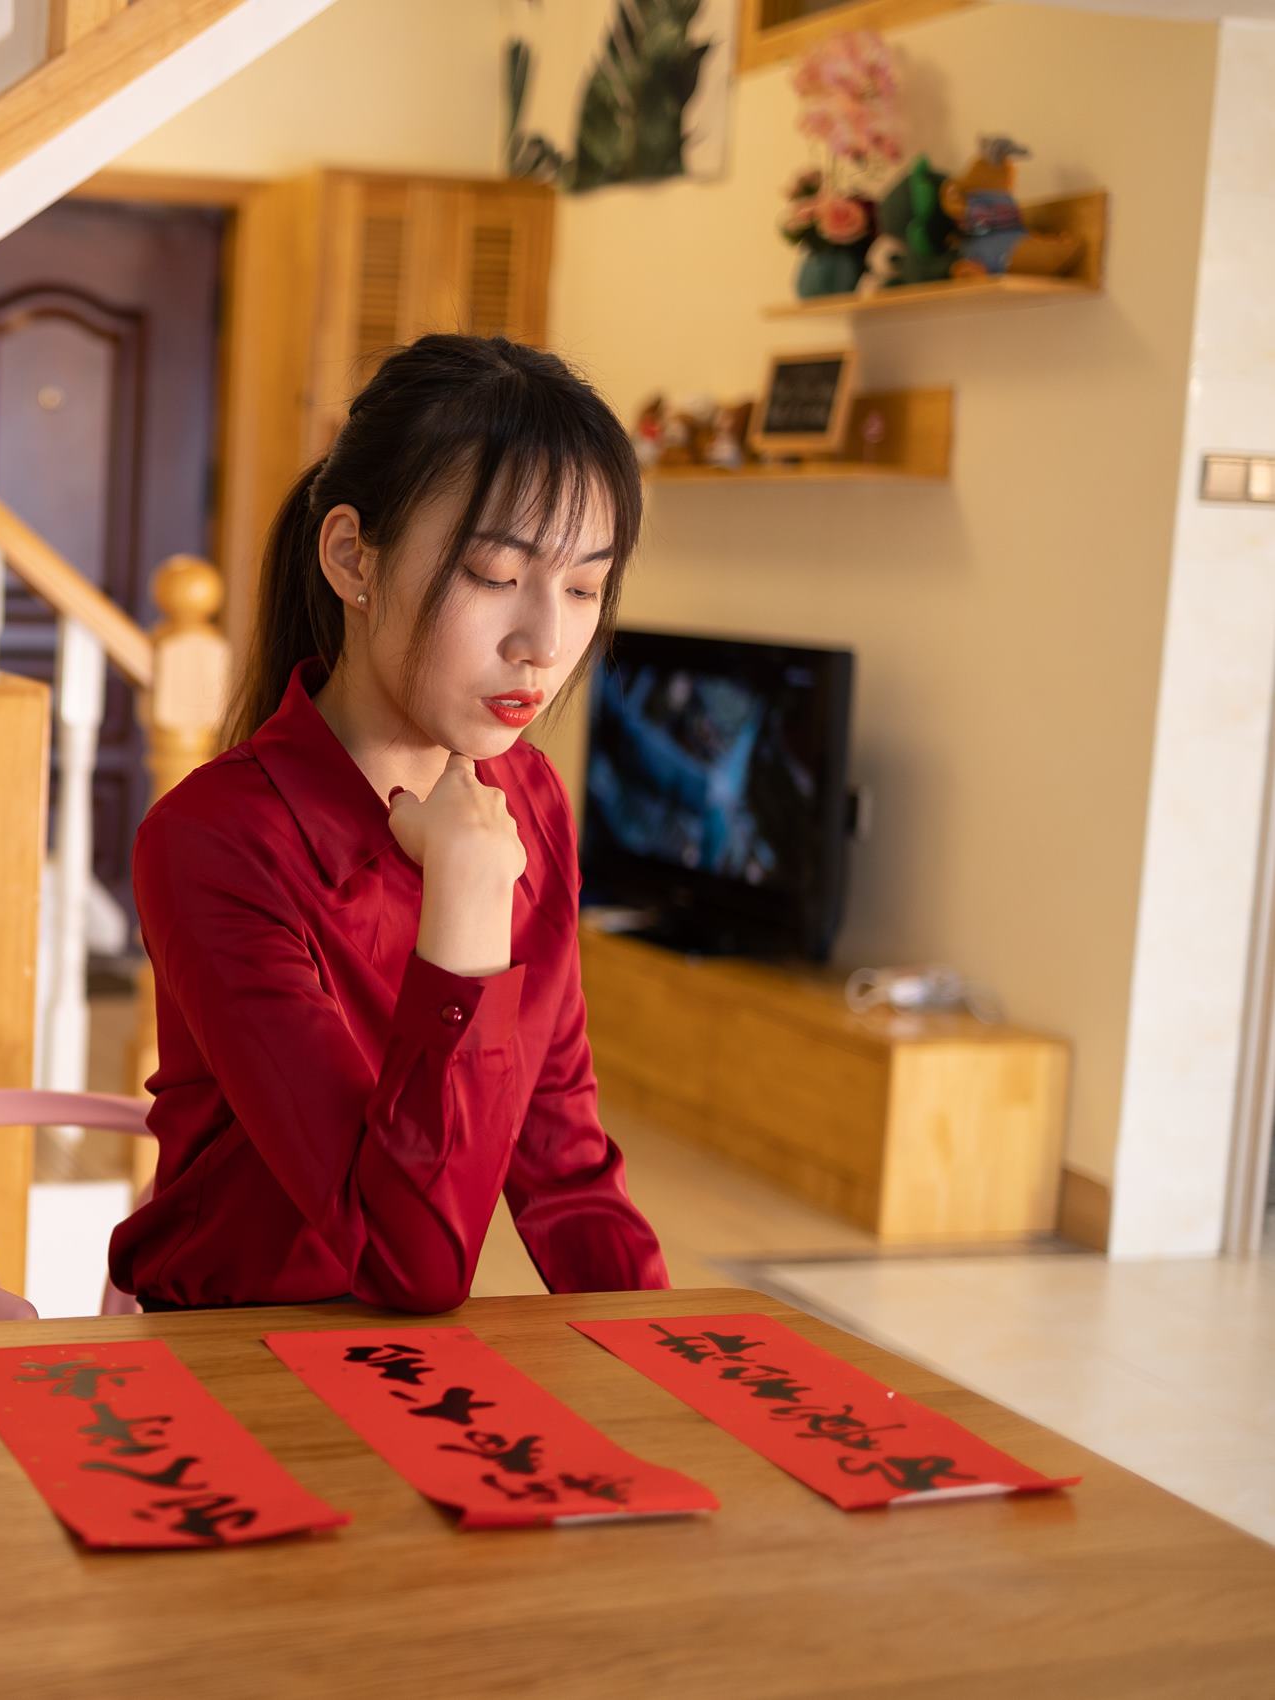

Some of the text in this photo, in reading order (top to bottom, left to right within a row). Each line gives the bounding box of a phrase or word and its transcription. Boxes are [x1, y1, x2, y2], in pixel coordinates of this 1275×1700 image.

[13, 1360, 259, 1539] 出入平安
[343, 1344, 632, 1503] 新春大吉
[649, 1324, 979, 1491] 如意吉祥
